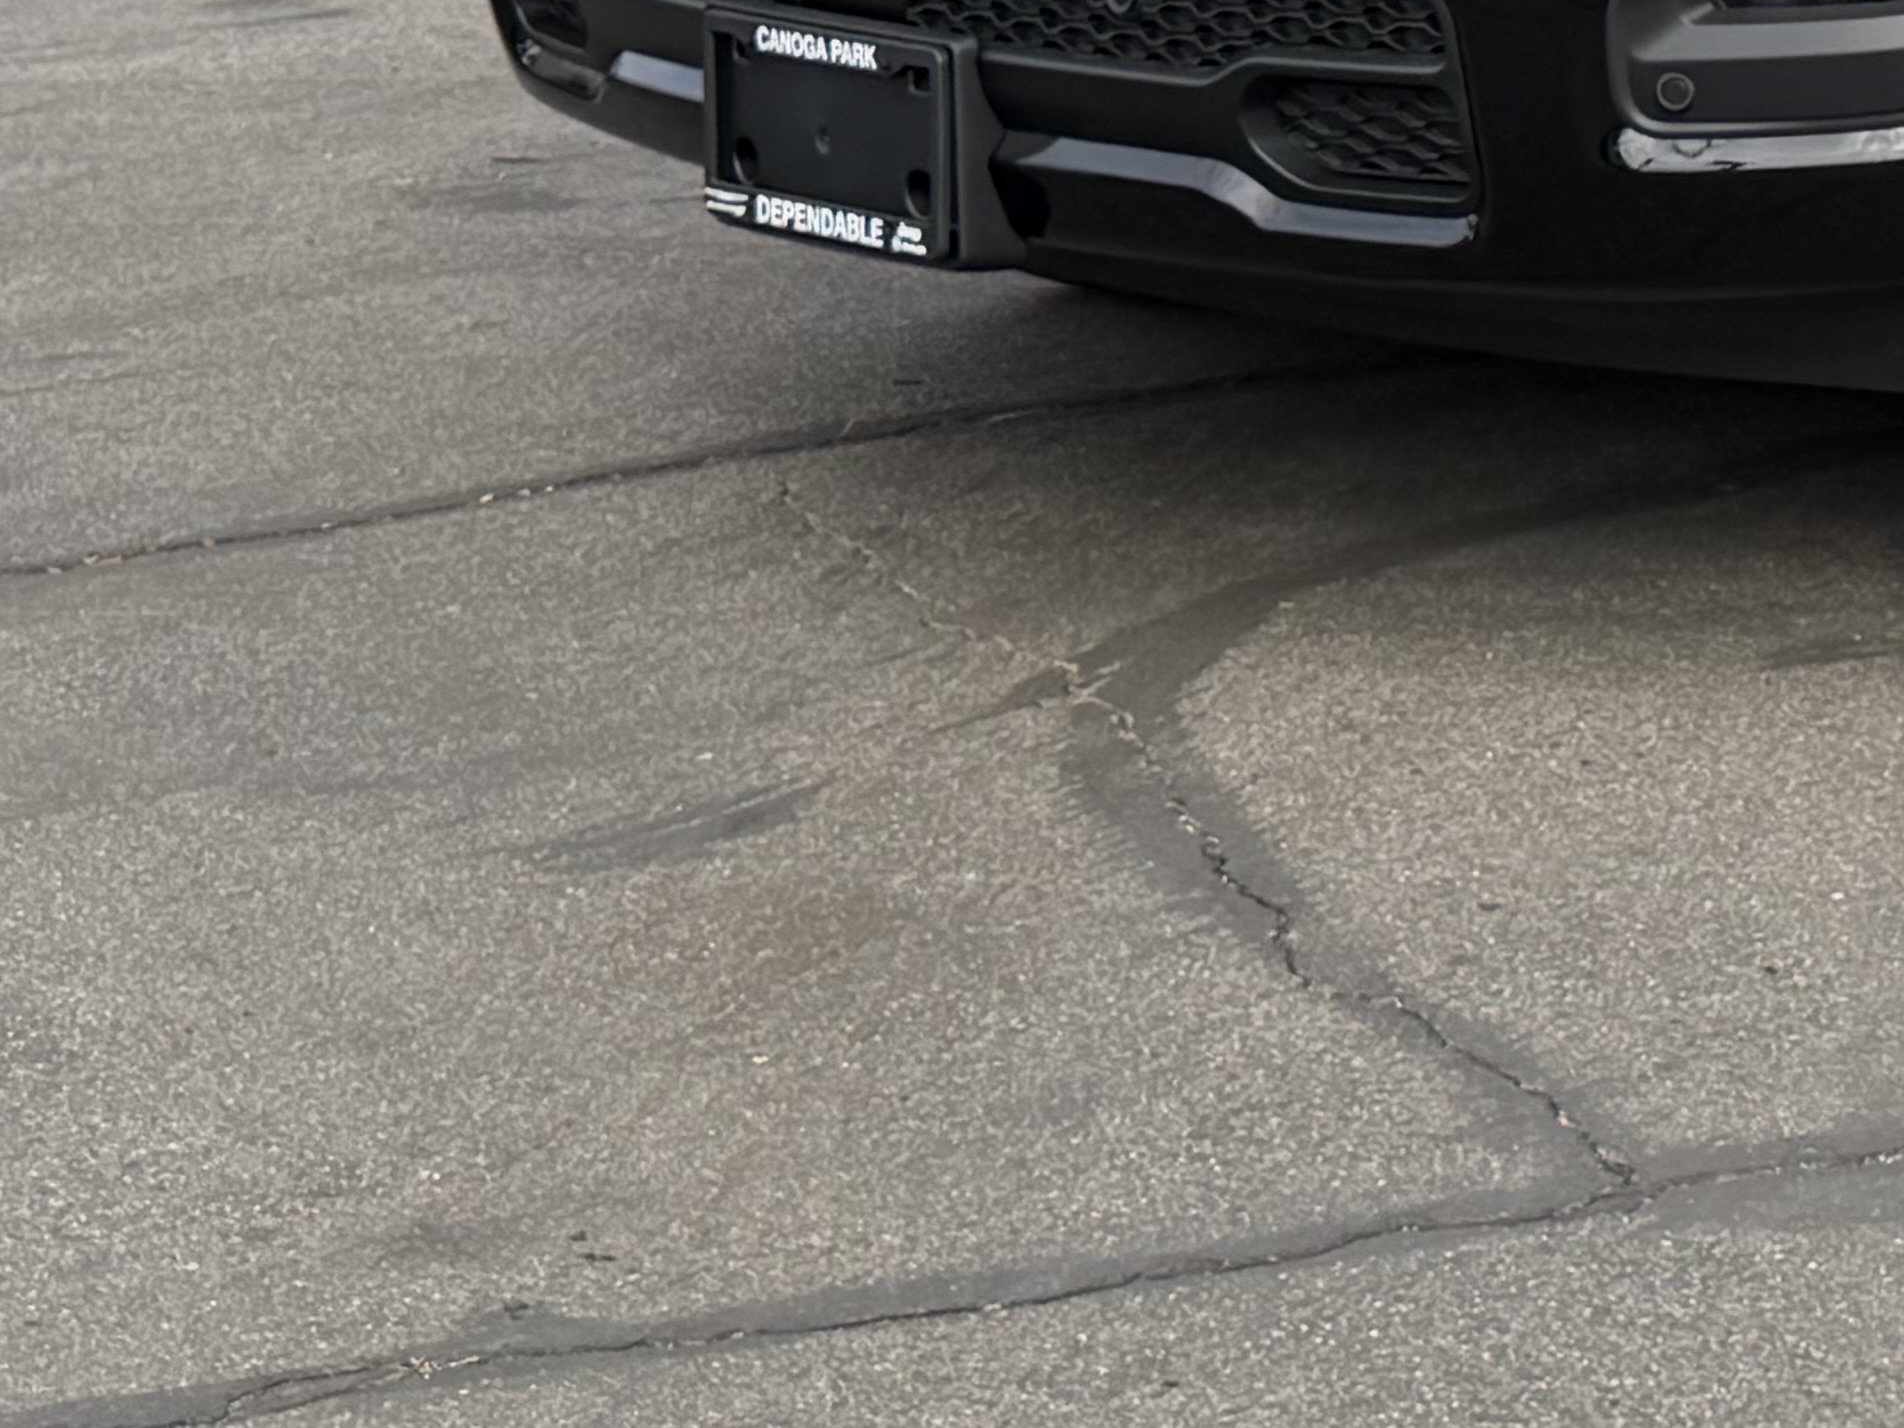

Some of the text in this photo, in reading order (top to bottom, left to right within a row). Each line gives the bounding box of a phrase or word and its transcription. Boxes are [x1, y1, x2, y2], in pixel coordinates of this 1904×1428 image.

[755, 25, 877, 70] CANOGA PARK
[755, 194, 884, 248] DEPENDABLE
